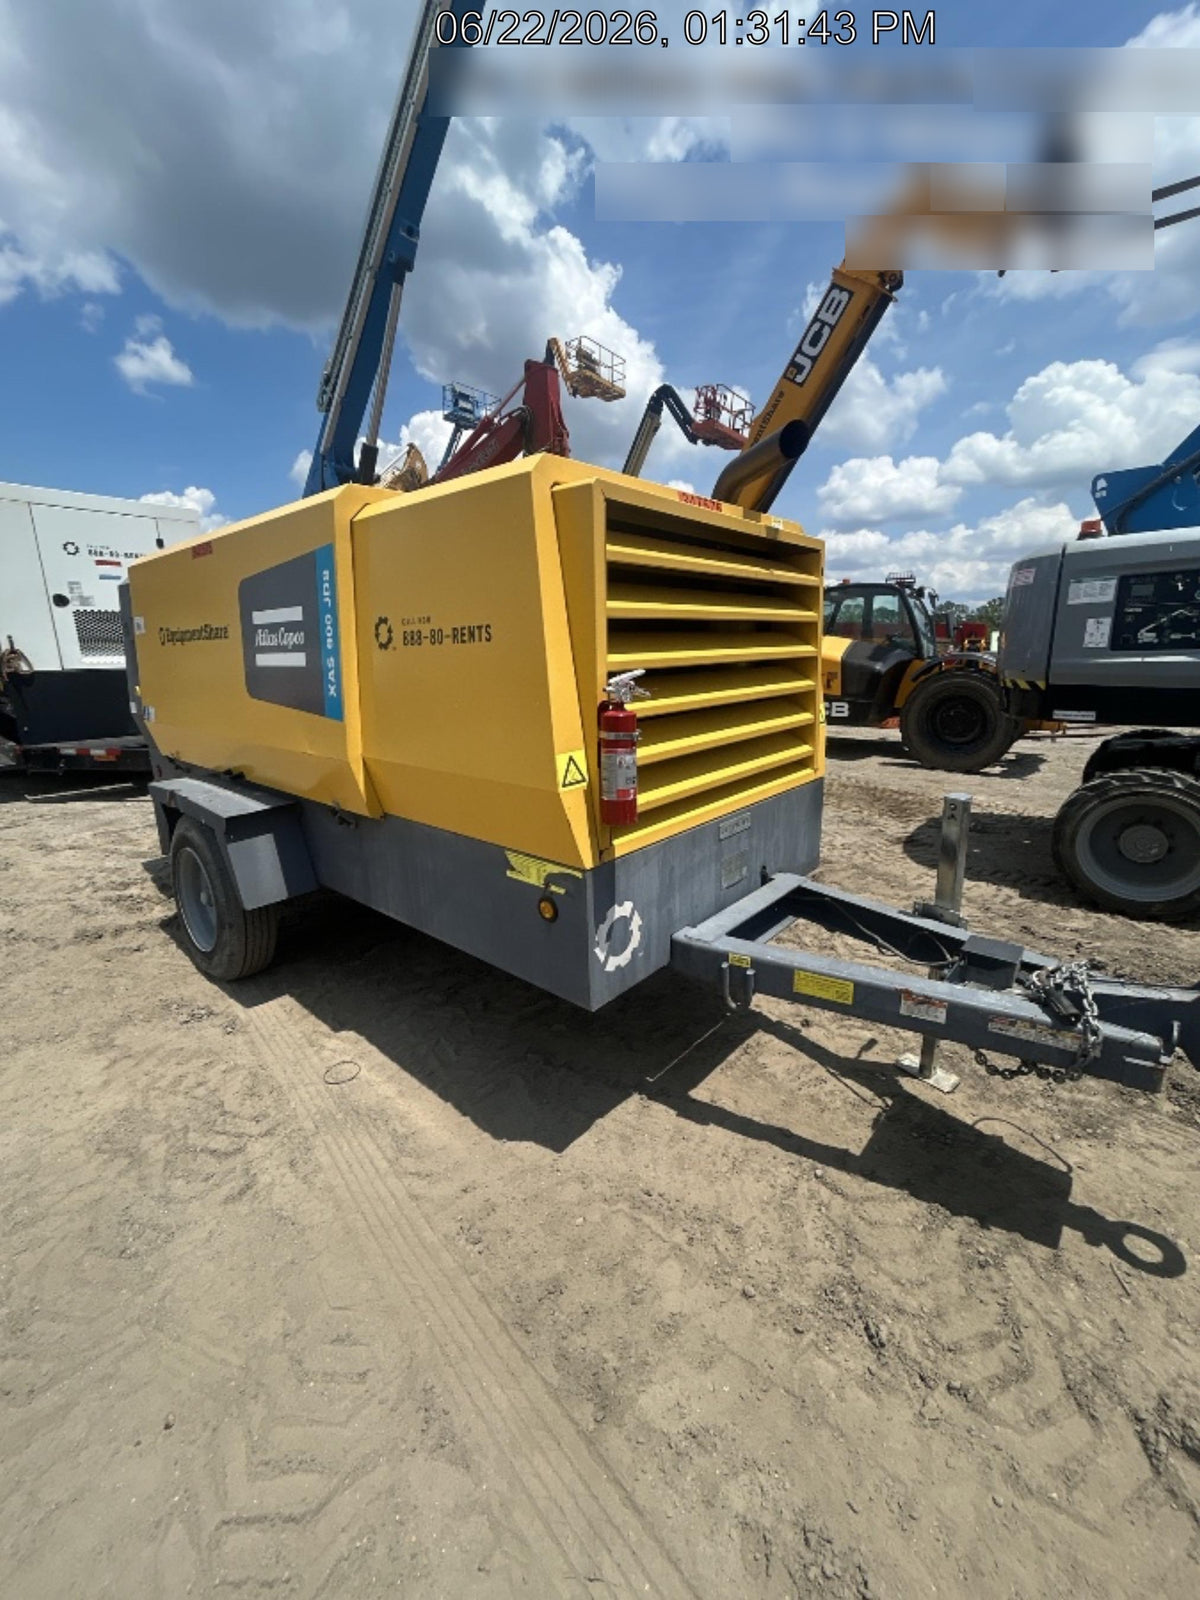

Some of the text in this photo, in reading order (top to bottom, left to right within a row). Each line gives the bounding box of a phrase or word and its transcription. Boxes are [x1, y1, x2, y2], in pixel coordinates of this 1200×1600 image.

[793, 287, 851, 385] JCB
[255, 627, 305, 650] Atlas Copco
[402, 624, 493, 647] 888-80-RENTS
[326, 656, 337, 698] XAS
[824, 701, 849, 717] B
